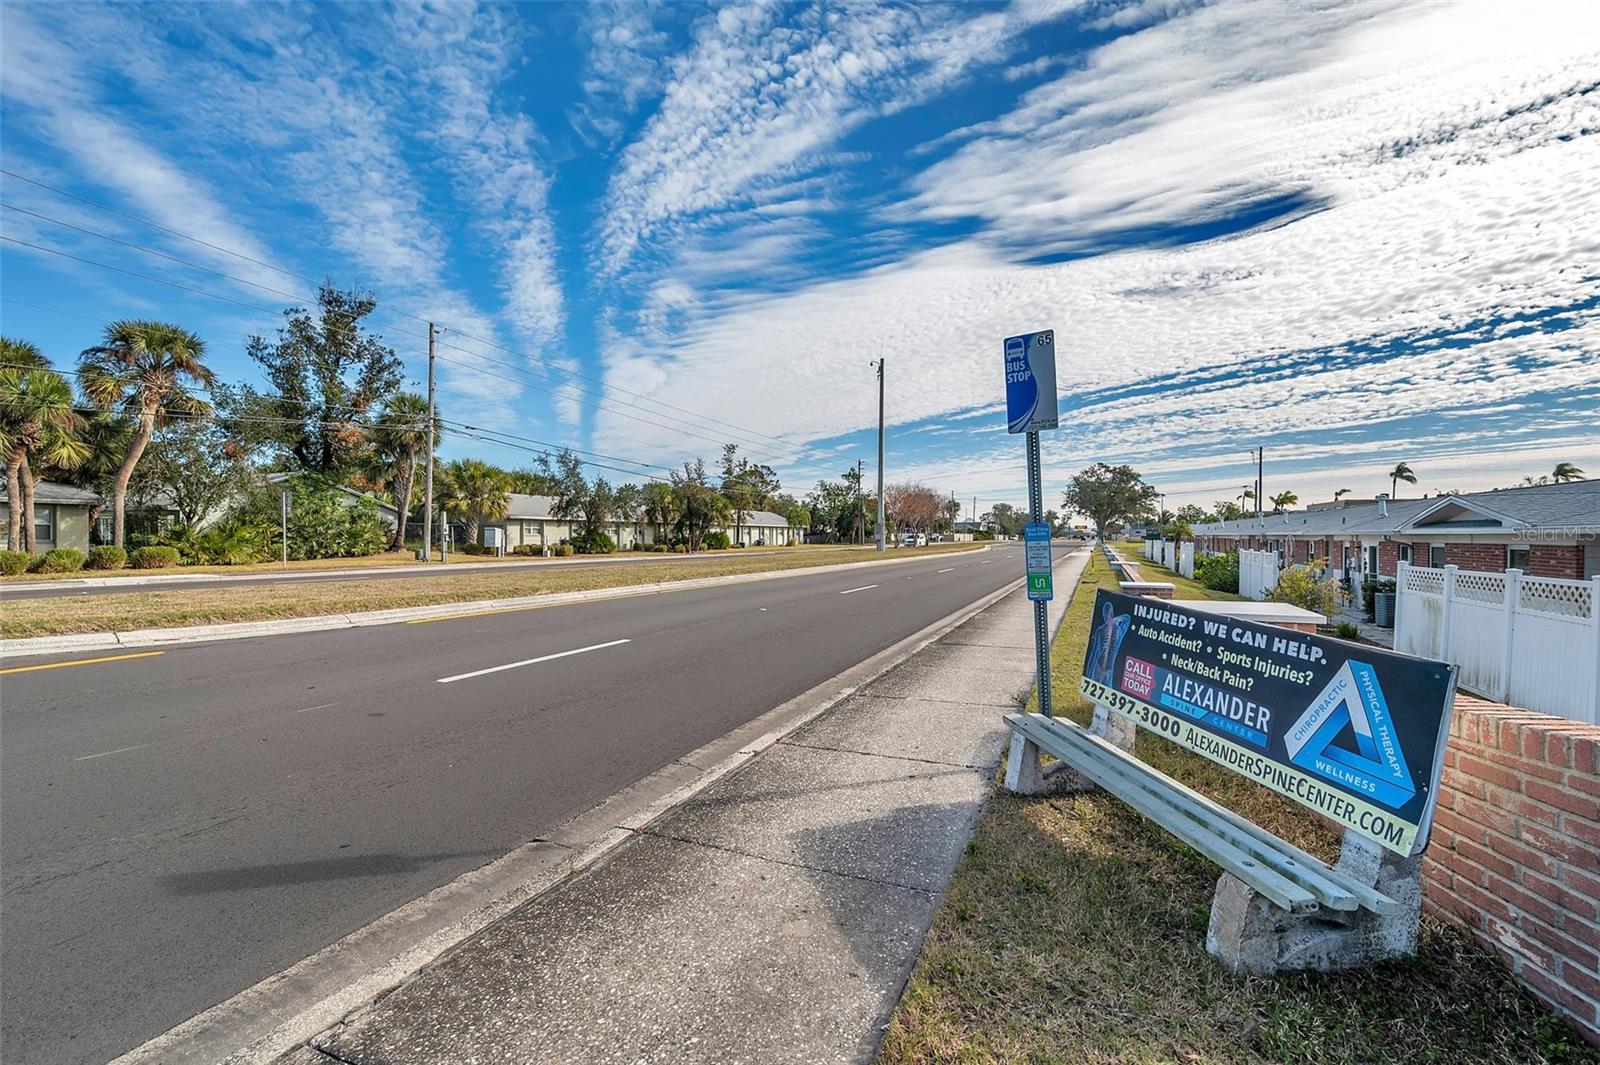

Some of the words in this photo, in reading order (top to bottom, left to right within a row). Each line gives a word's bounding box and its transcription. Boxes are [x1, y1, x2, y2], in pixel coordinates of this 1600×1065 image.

[1037, 334, 1052, 346] 65
[1007, 360, 1026, 372] BUS
[1007, 371, 1031, 384] STOP
[1134, 604, 1196, 630] INJURED?
[1203, 620, 1228, 639] WE
[1231, 627, 1268, 649] CAN
[1272, 637, 1327, 665] HELP.
[1126, 659, 1152, 680] CALL
[1138, 624, 1158, 641] Auto
[1158, 630, 1202, 653] Accident?
[1216, 646, 1252, 668] Sports
[1254, 656, 1314, 686] Injuries?
[1170, 653, 1221, 681] Neck/Back
[1223, 669, 1254, 692] Pain?
[1123, 677, 1151, 696] TODAY
[1124, 671, 1135, 679] OUR
[1135, 675, 1152, 685] OFFICE
[1082, 679, 1181, 737] 727-397-3000
[1162, 673, 1271, 733] ALEXANDER
[1170, 699, 1196, 715] SPINE
[1212, 716, 1254, 739] CENTER
[1294, 679, 1348, 742] CHIROPRACTIC
[1359, 670, 1381, 724] PHYSICAL
[1377, 724, 1404, 779] THERAPY
[1315, 759, 1377, 793] WELLNESS
